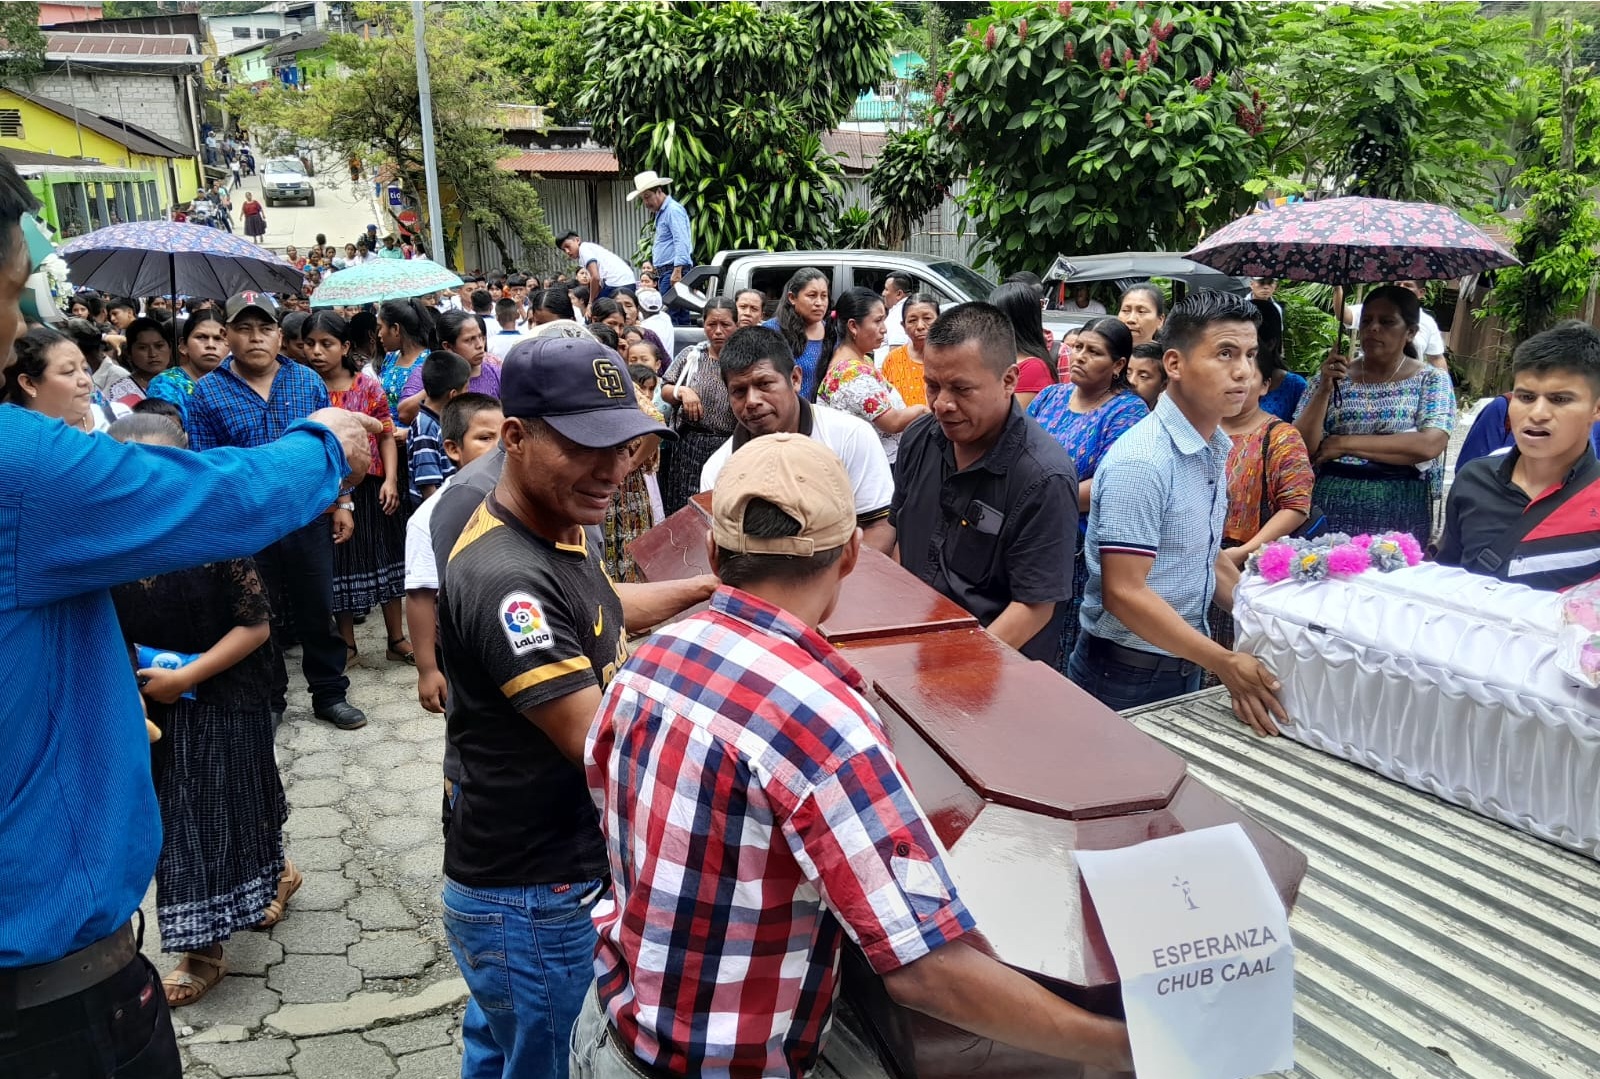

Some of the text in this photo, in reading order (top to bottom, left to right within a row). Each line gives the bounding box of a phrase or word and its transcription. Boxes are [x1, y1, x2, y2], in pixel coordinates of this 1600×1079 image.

[241, 290, 259, 305] T
[514, 633, 550, 649] LaLiga
[1152, 925, 1278, 968] ESPERANZA
[1157, 956, 1276, 996] CHUB CAAL
